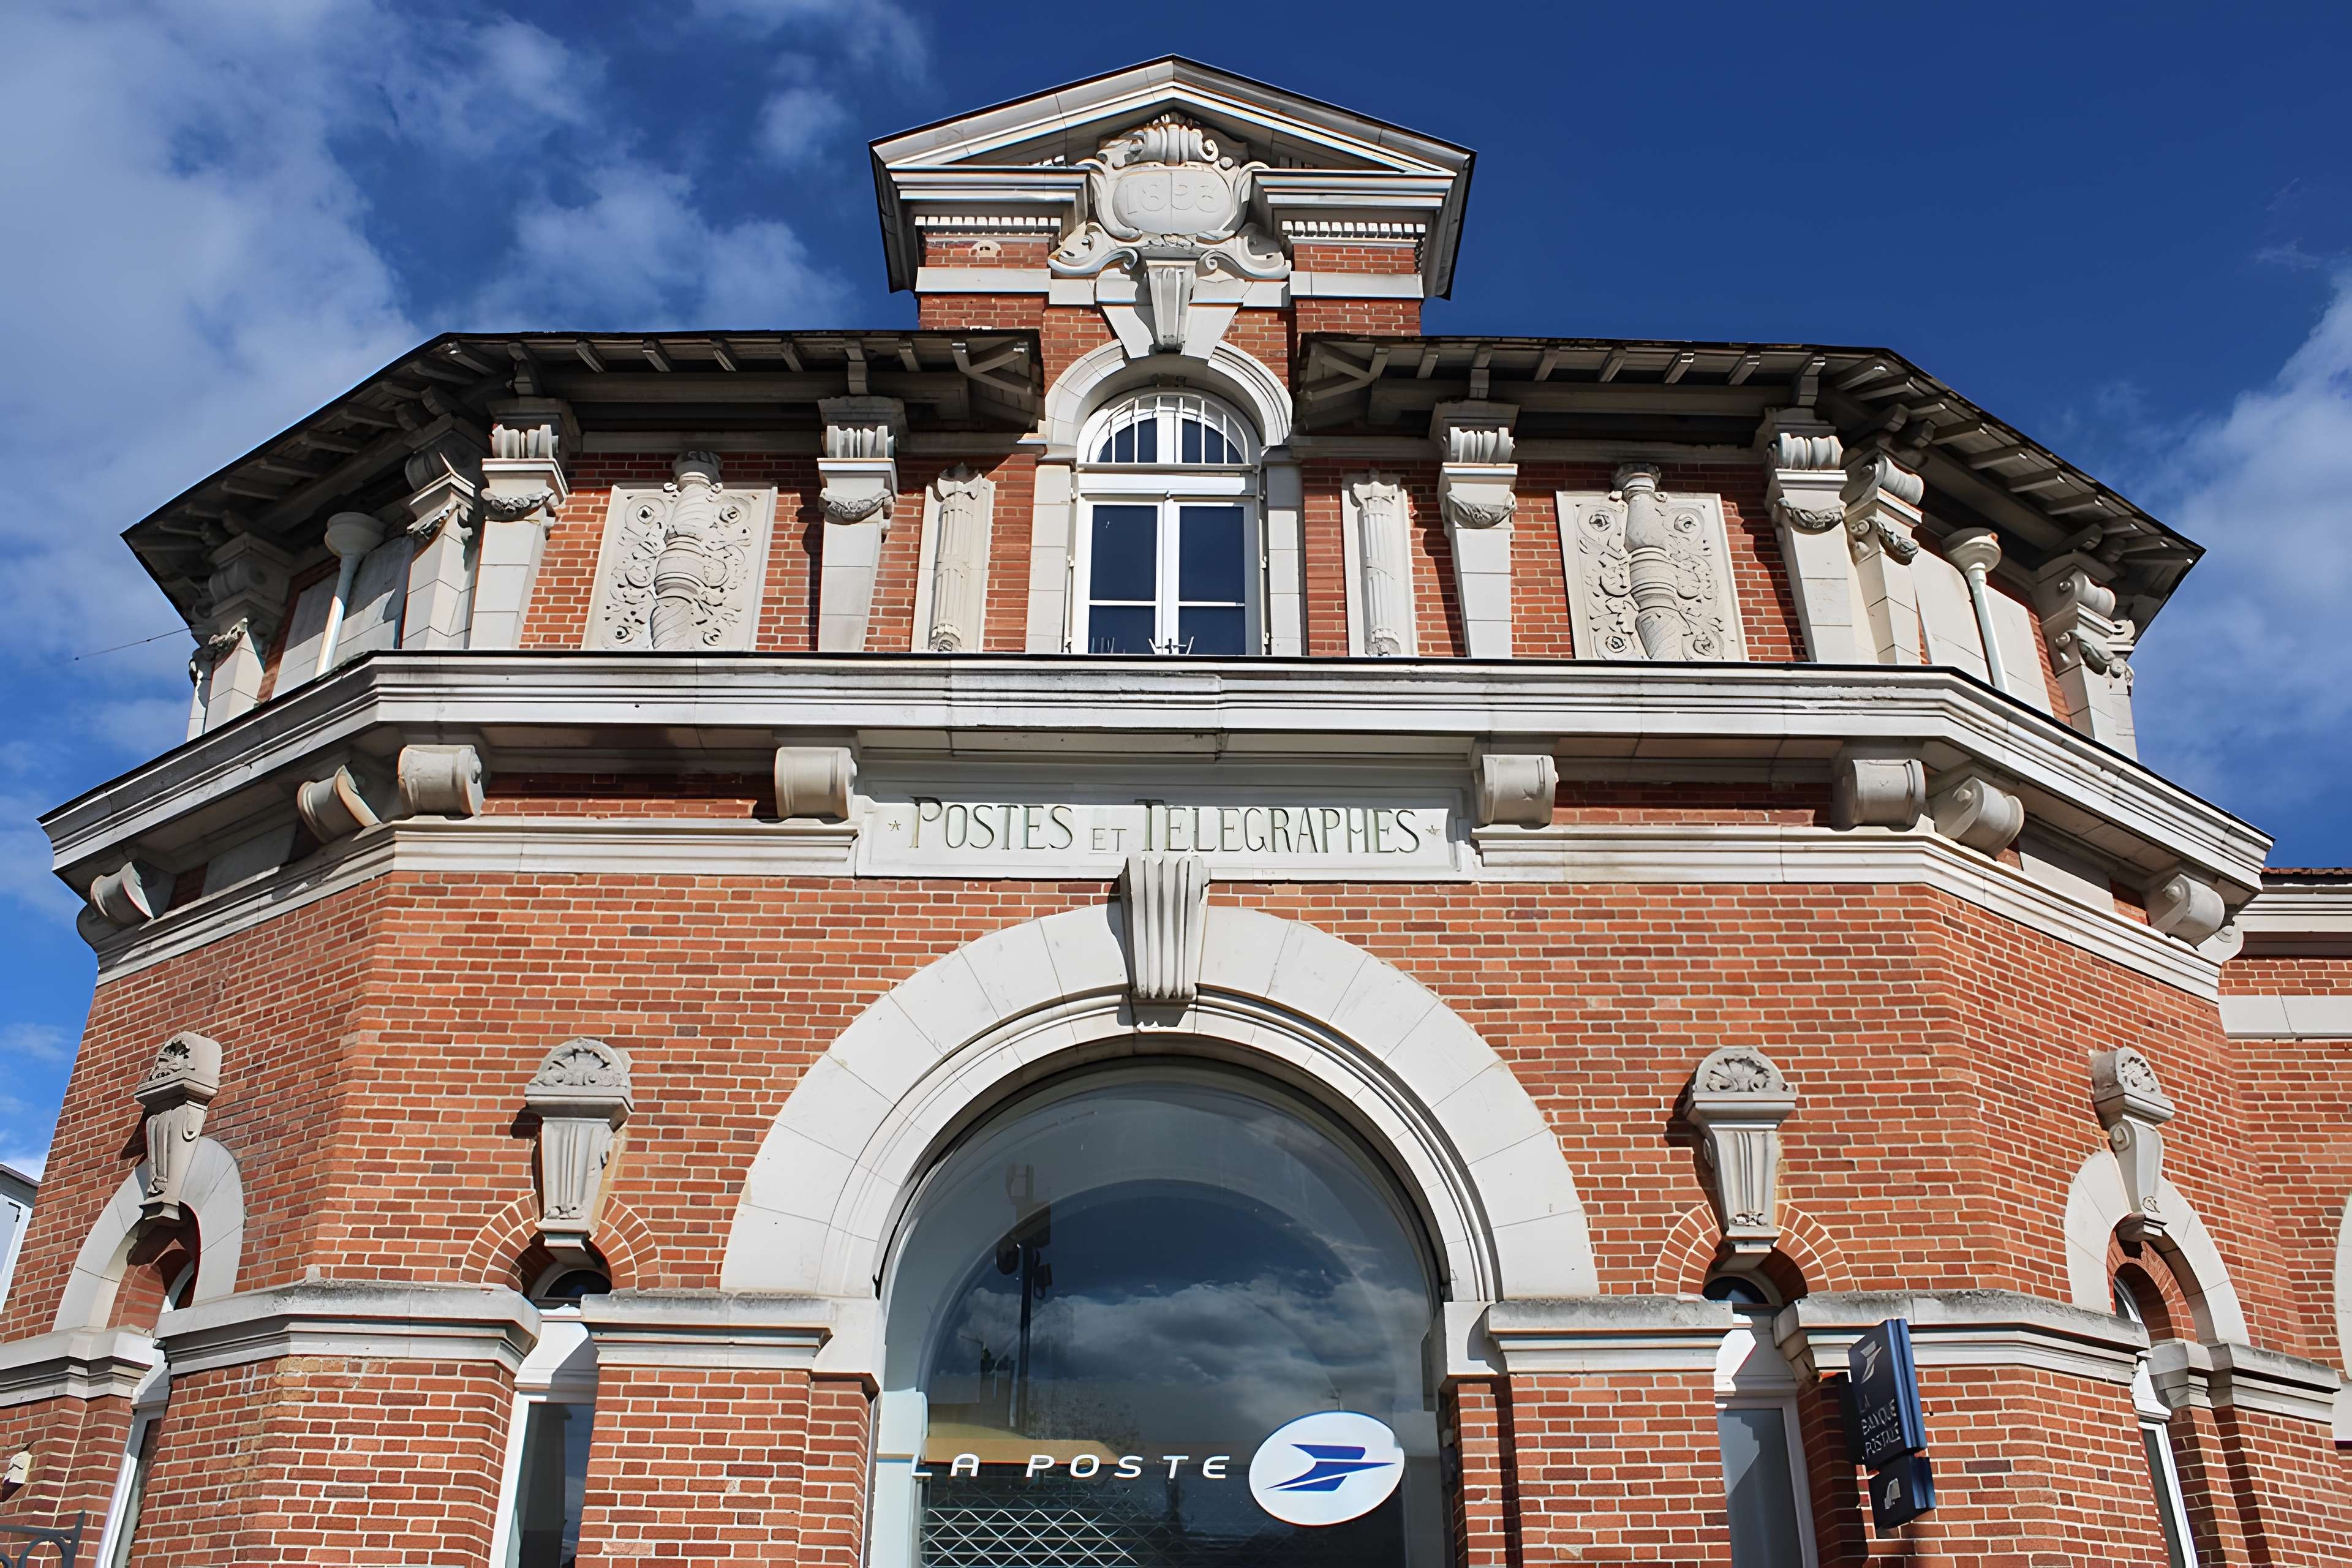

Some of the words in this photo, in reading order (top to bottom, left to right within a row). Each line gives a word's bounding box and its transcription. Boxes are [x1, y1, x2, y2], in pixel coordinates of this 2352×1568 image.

[909, 796, 1073, 850] POSTES
[1090, 827, 1126, 852] ET
[1134, 799, 1420, 853] TELEGRAPHES
[910, 1452, 981, 1478] LA
[1025, 1453, 1230, 1479] POSTE
